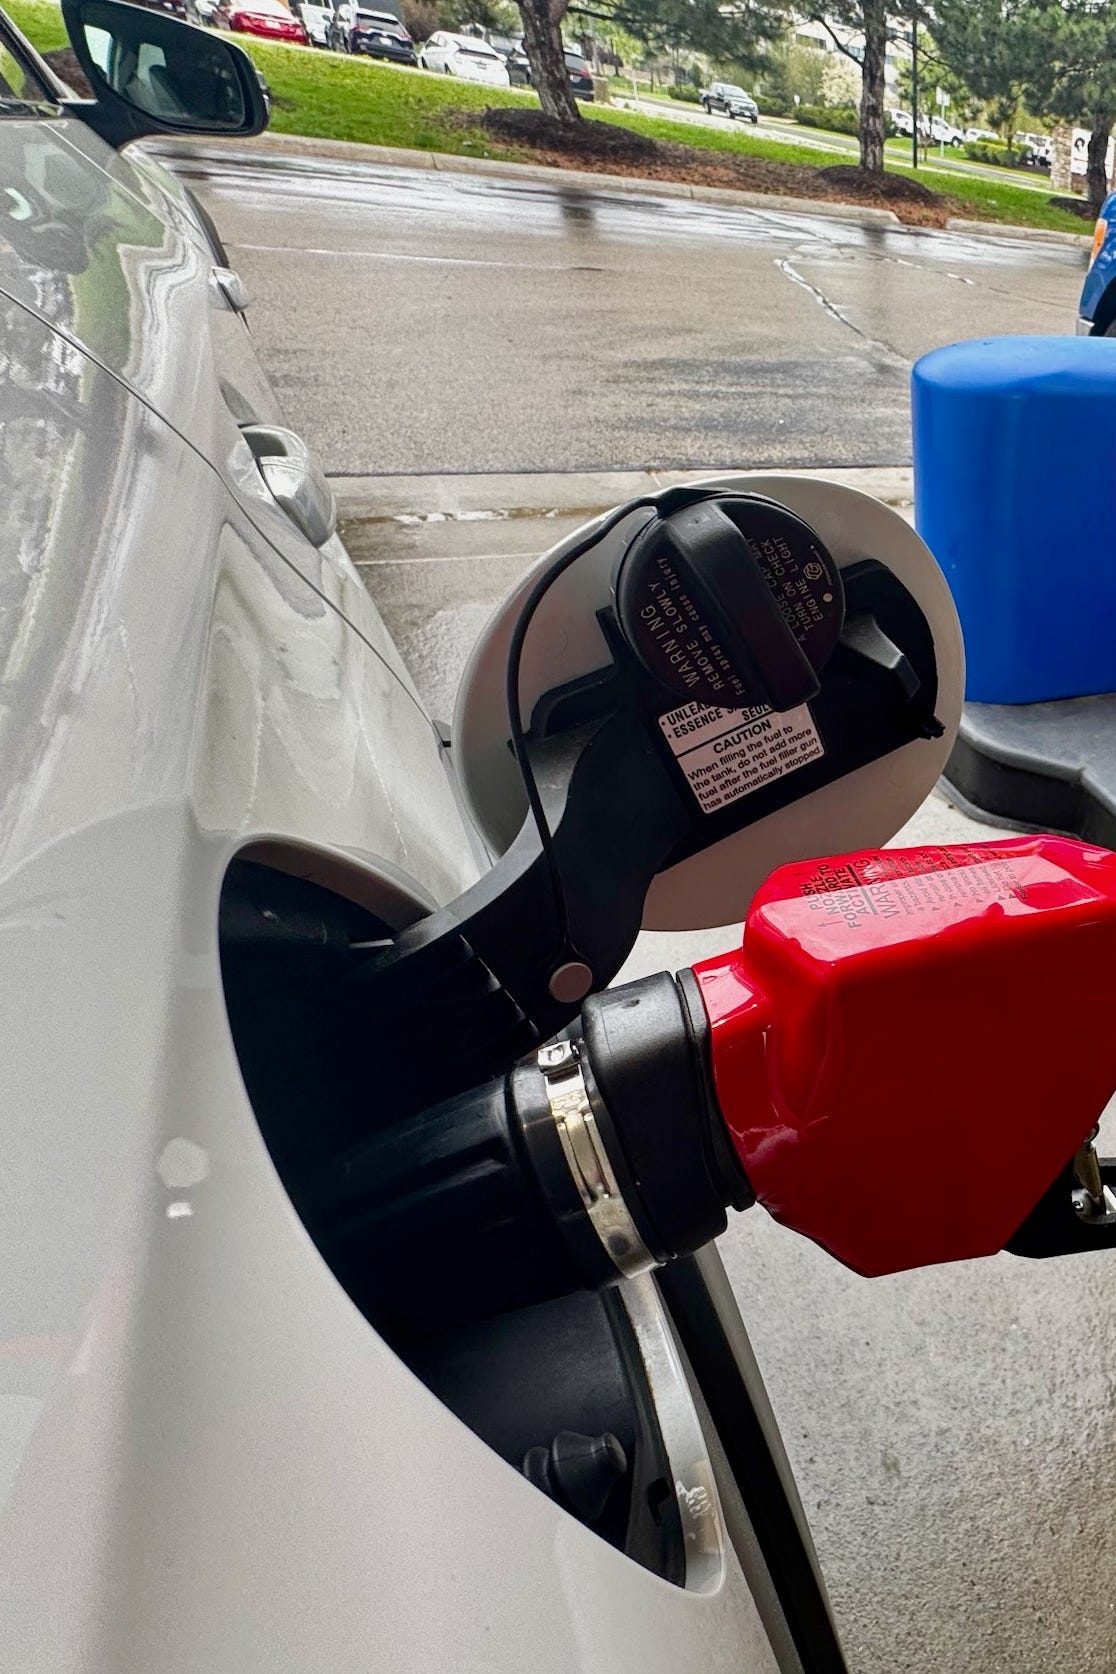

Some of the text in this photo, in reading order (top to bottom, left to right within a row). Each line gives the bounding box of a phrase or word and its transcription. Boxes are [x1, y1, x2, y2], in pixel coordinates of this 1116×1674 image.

[760, 539, 814, 632] TURN ON CHECK
[772, 537, 824, 622] ENGINE LIGHT
[679, 594, 700, 621] cause
[640, 604, 700, 688] WARNING
[648, 582, 725, 691] REMOVE SLOWLY
[698, 625, 713, 642] may
[710, 644, 731, 671] spray
[727, 674, 746, 696] Fuel
[672, 708, 723, 739] ESSENCE
[713, 718, 772, 754] CAUTION
[741, 704, 774, 721] SEUL
[687, 725, 793, 781] When filling the fuel to
[693, 728, 812, 791] the tank, do not add more
[698, 736, 818, 801] fuel after the fuel filler gun
[703, 798, 723, 811] has
[723, 765, 783, 801] automatically
[800, 883, 823, 911] PUSH
[810, 875, 840, 915] NOZZLE
[817, 863, 862, 928] FORWARD TO
[834, 867, 870, 915] ACTIVATE
[853, 859, 900, 919] WARNING
